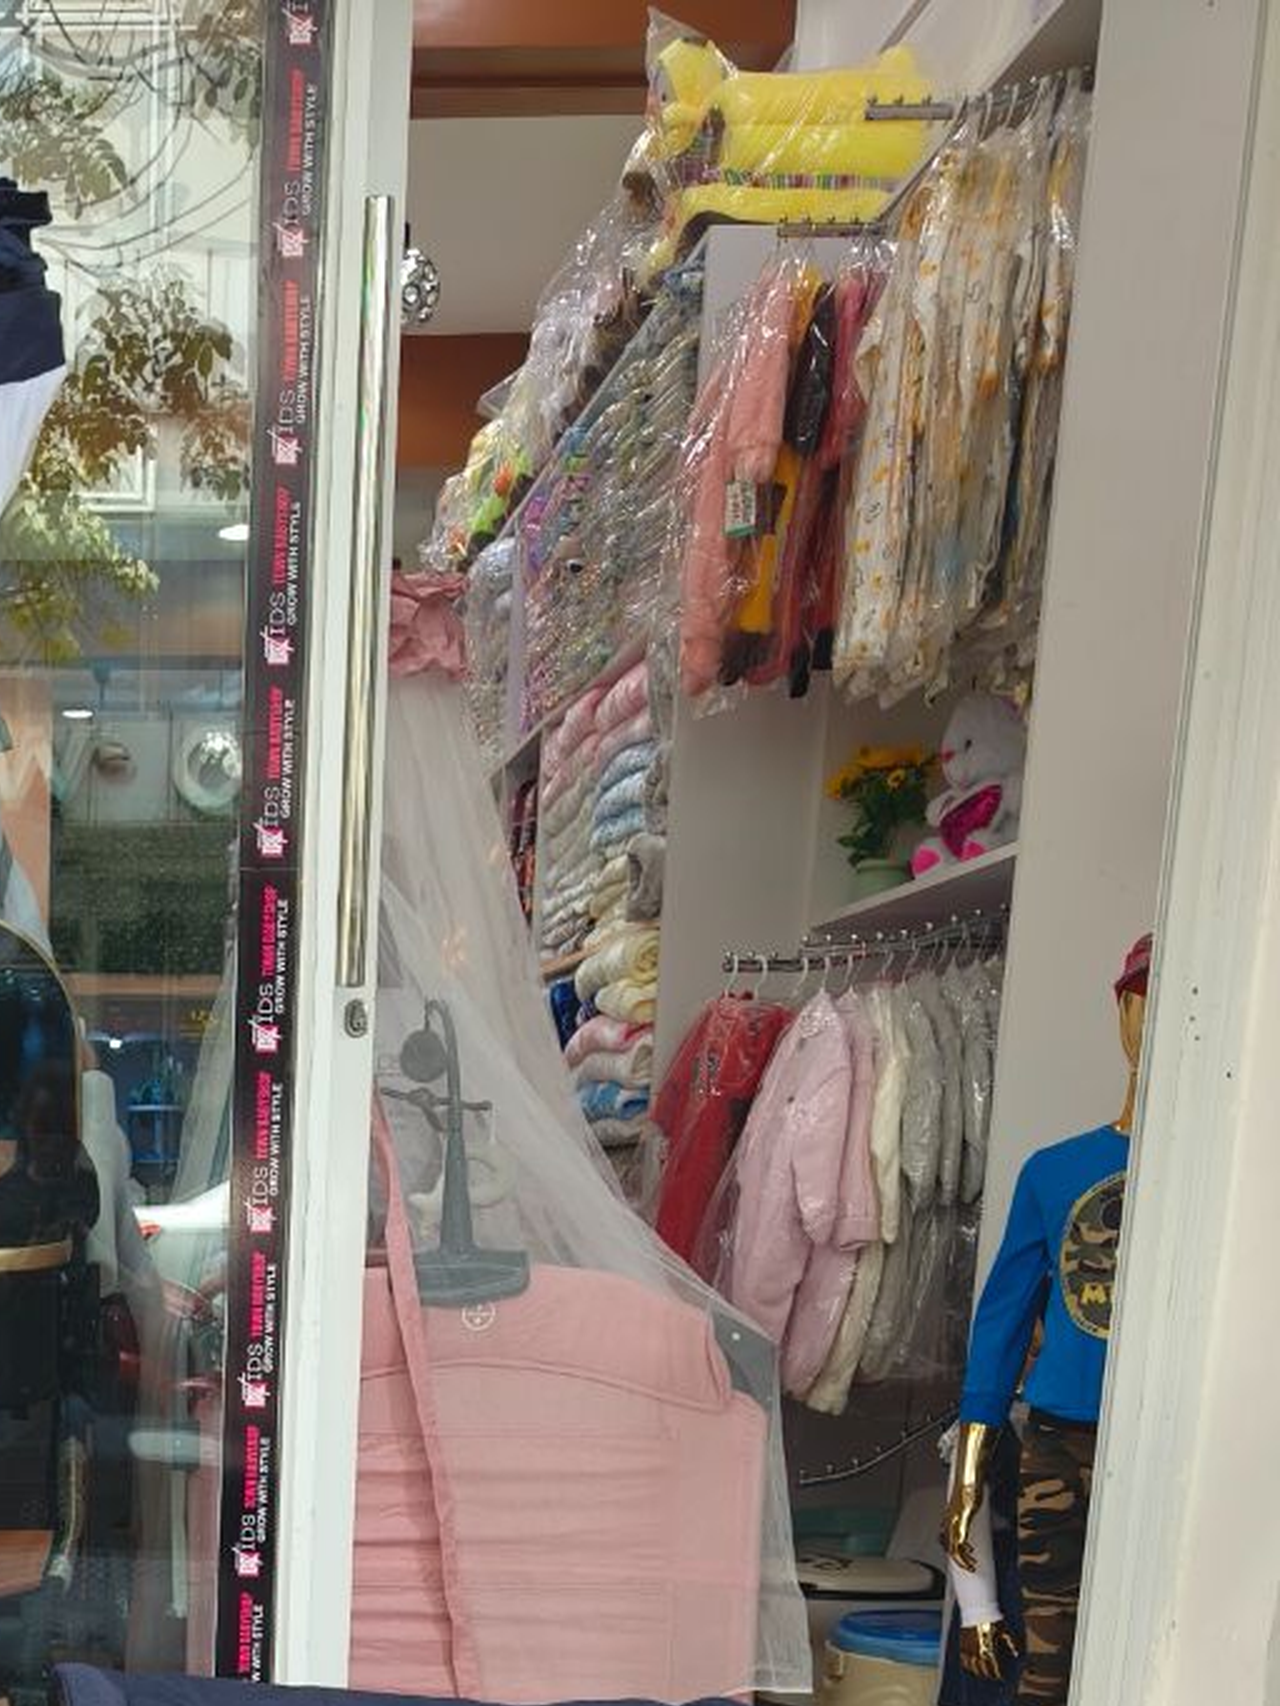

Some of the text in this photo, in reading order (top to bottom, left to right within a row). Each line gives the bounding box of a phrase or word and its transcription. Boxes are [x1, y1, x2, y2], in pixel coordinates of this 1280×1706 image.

[301, 84, 317, 215] GROW WITH STYLE
[296, 295, 311, 424] GROW WITH STYLE
[286, 502, 302, 625] GROW WITH STYLE
[280, 699, 295, 819] GROW WITH STYLE
[273, 899, 288, 1014] GROW WITH STYLE
[269, 1082, 283, 1197] GROW WITH STYLE
[263, 1263, 277, 1373] GROW WITH STYLE
[257, 1437, 271, 1543] GROW WITH STYLE
[252, 1604, 265, 1640] STYLE
[252, 1641, 263, 1673] WITH
